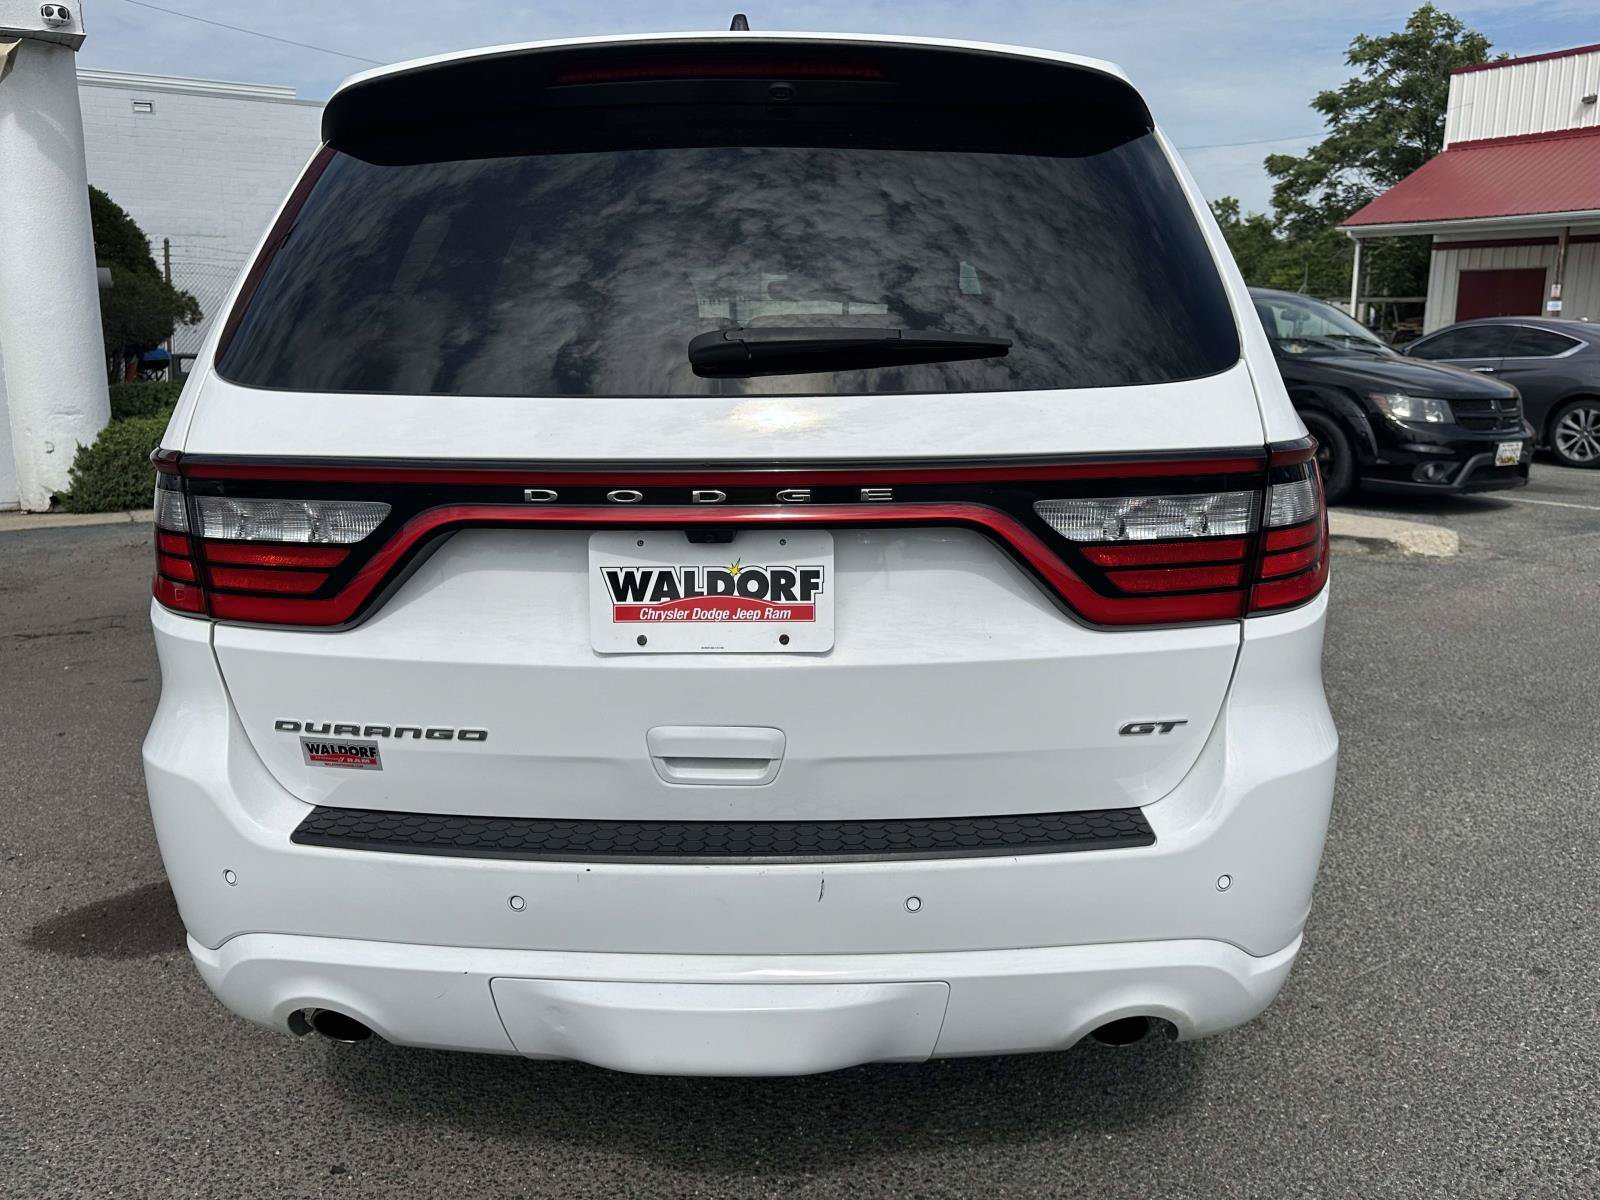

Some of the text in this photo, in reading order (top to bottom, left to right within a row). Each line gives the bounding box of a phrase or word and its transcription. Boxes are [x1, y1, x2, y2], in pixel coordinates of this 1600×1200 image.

[524, 487, 893, 503] DODGE
[602, 567, 823, 603] WALDORF
[639, 607, 792, 622] Chrysler Dodge Jeep Ram
[274, 720, 489, 742] DURANGO
[1119, 720, 1188, 736] GT
[305, 743, 377, 758] WALDORF
